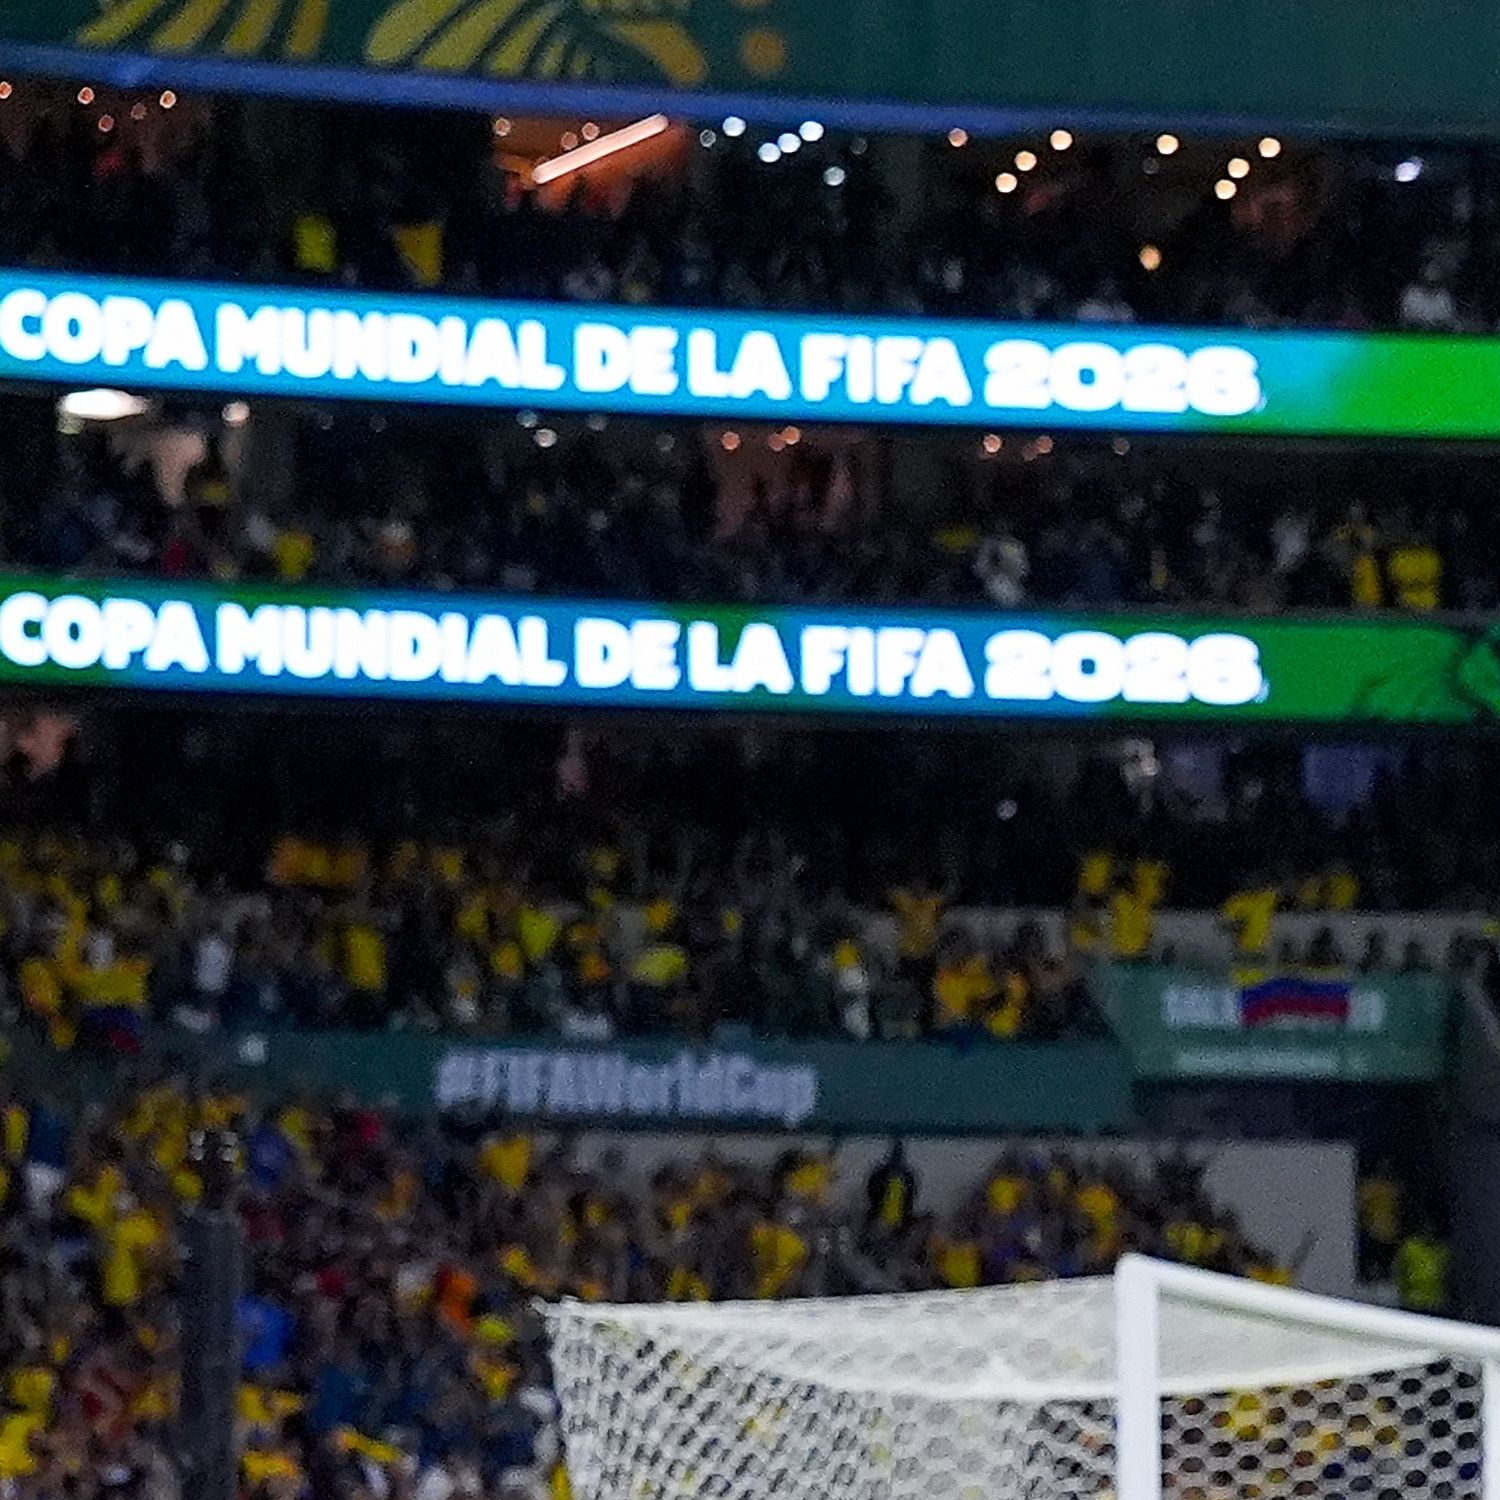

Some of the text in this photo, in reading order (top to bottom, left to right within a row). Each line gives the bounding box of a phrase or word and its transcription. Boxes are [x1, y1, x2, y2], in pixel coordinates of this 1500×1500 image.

[1, 289, 1261, 416] COPA MUNDIAL DE LA FIFA 2026
[1, 592, 1263, 705] COPA MUNDIAL DE LA FIFA 2026
